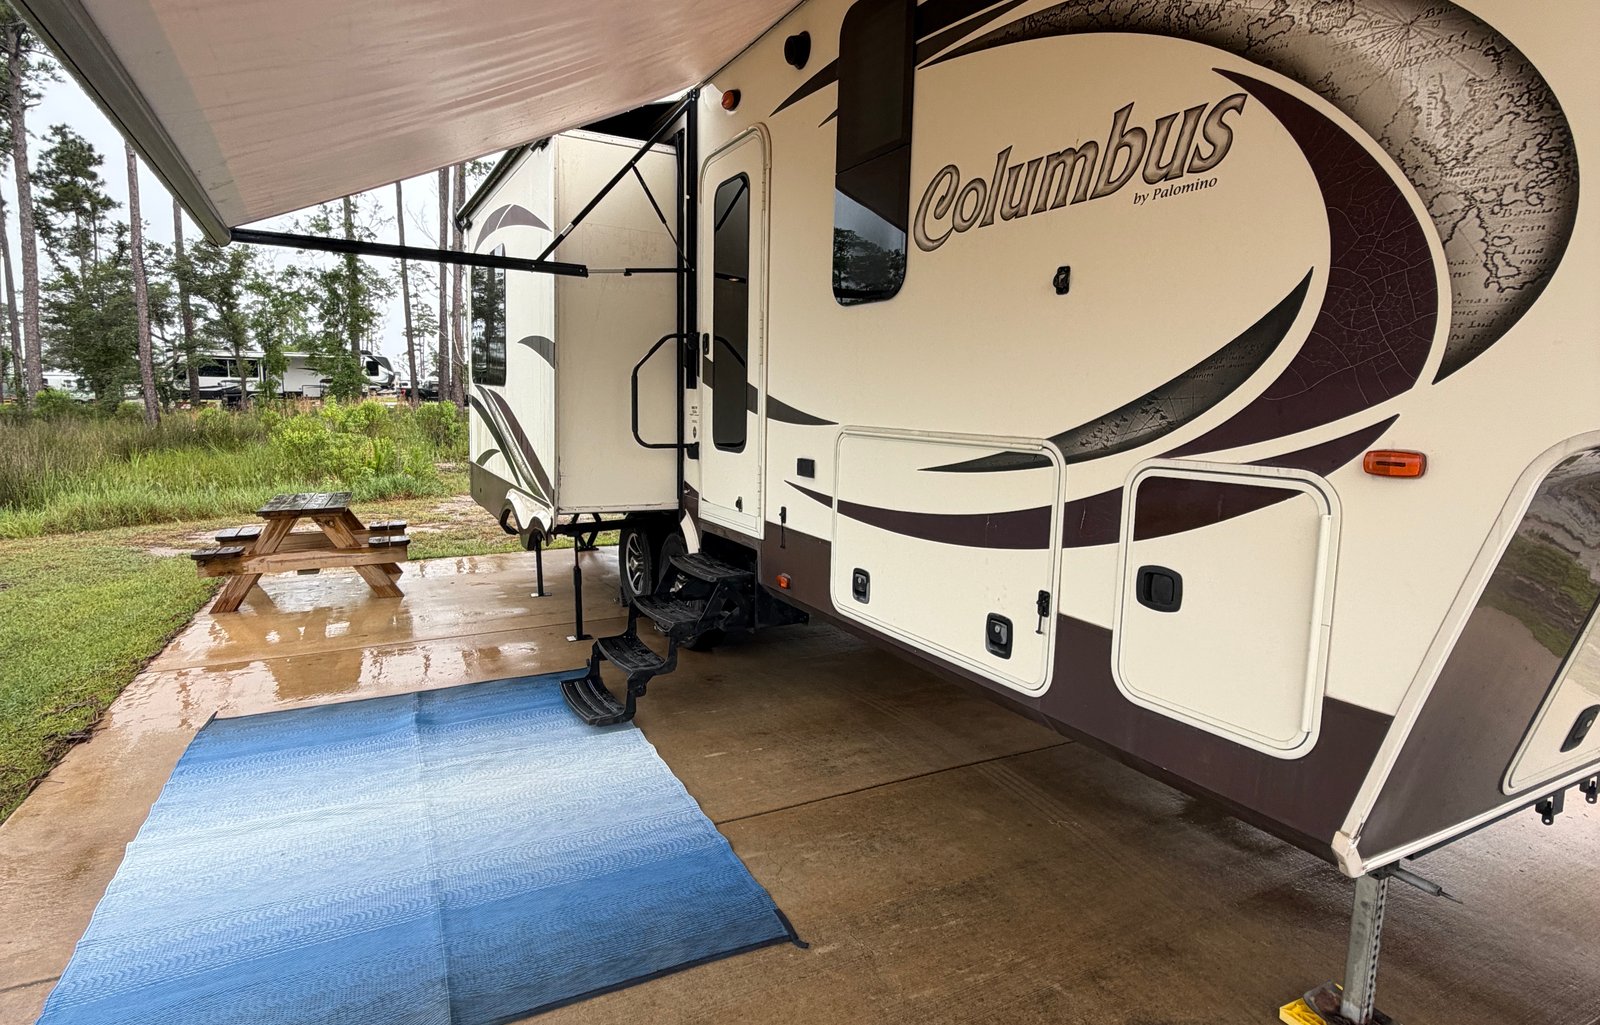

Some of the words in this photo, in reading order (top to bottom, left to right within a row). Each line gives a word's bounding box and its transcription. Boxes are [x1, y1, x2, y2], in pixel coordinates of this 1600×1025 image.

[913, 92, 1248, 252] Columbus
[1133, 190, 1150, 206] by
[1151, 176, 1218, 201] Palomino
